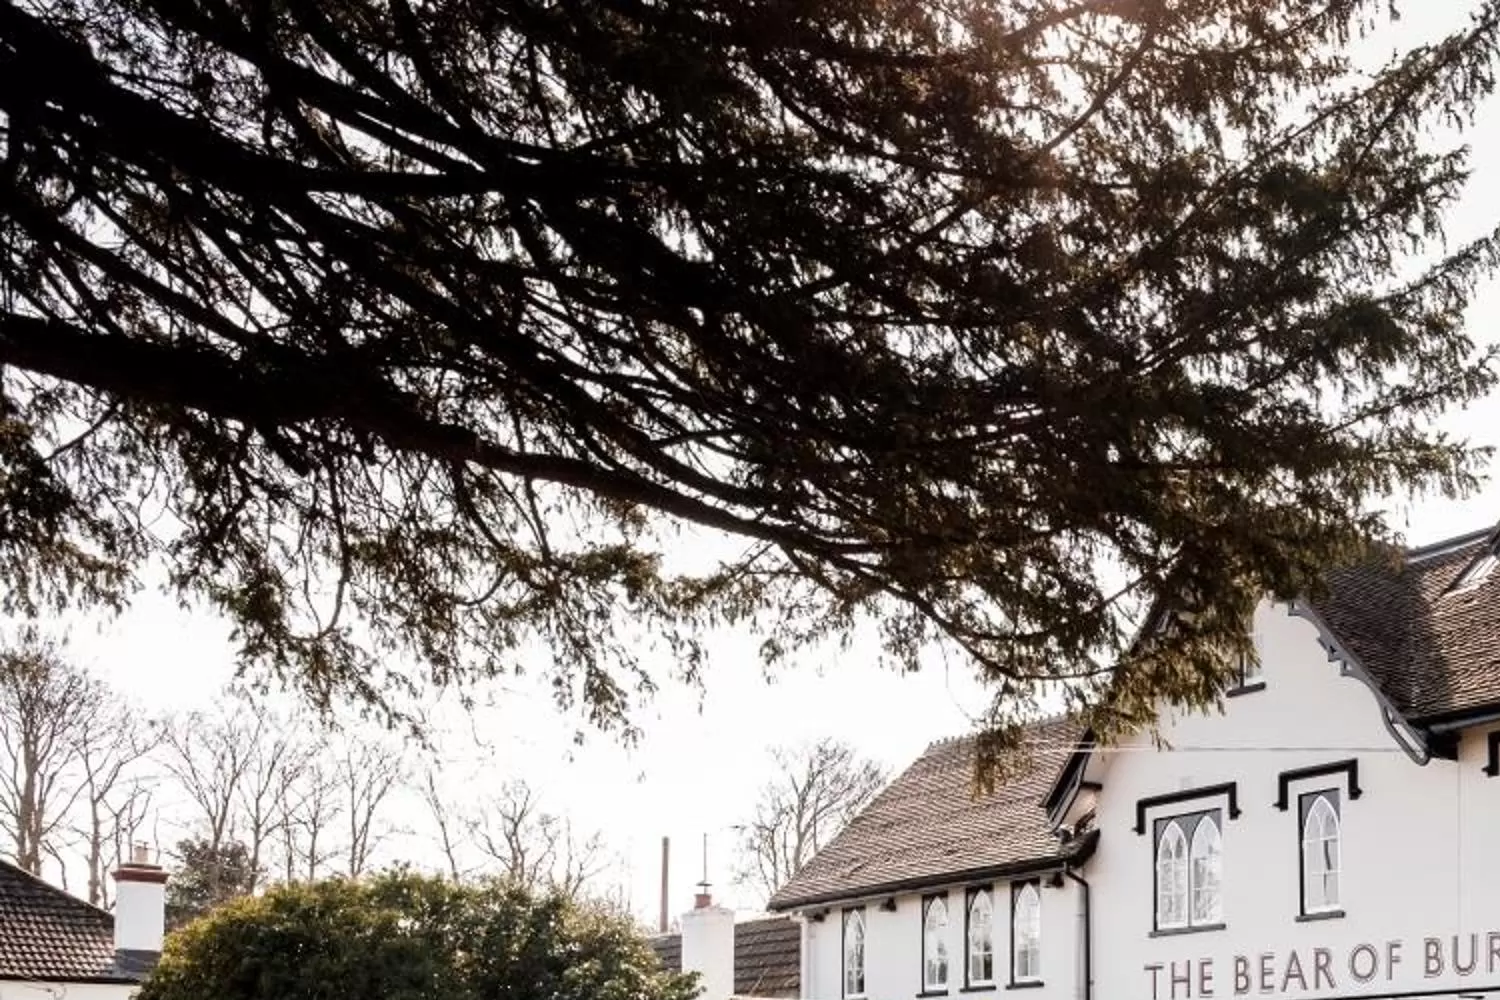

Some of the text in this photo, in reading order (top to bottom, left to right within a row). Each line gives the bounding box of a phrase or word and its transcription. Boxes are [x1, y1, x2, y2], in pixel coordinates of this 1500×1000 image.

[1144, 958, 1215, 1000] THE
[1233, 948, 1336, 995] BEAR
[1348, 940, 1404, 984] OF
